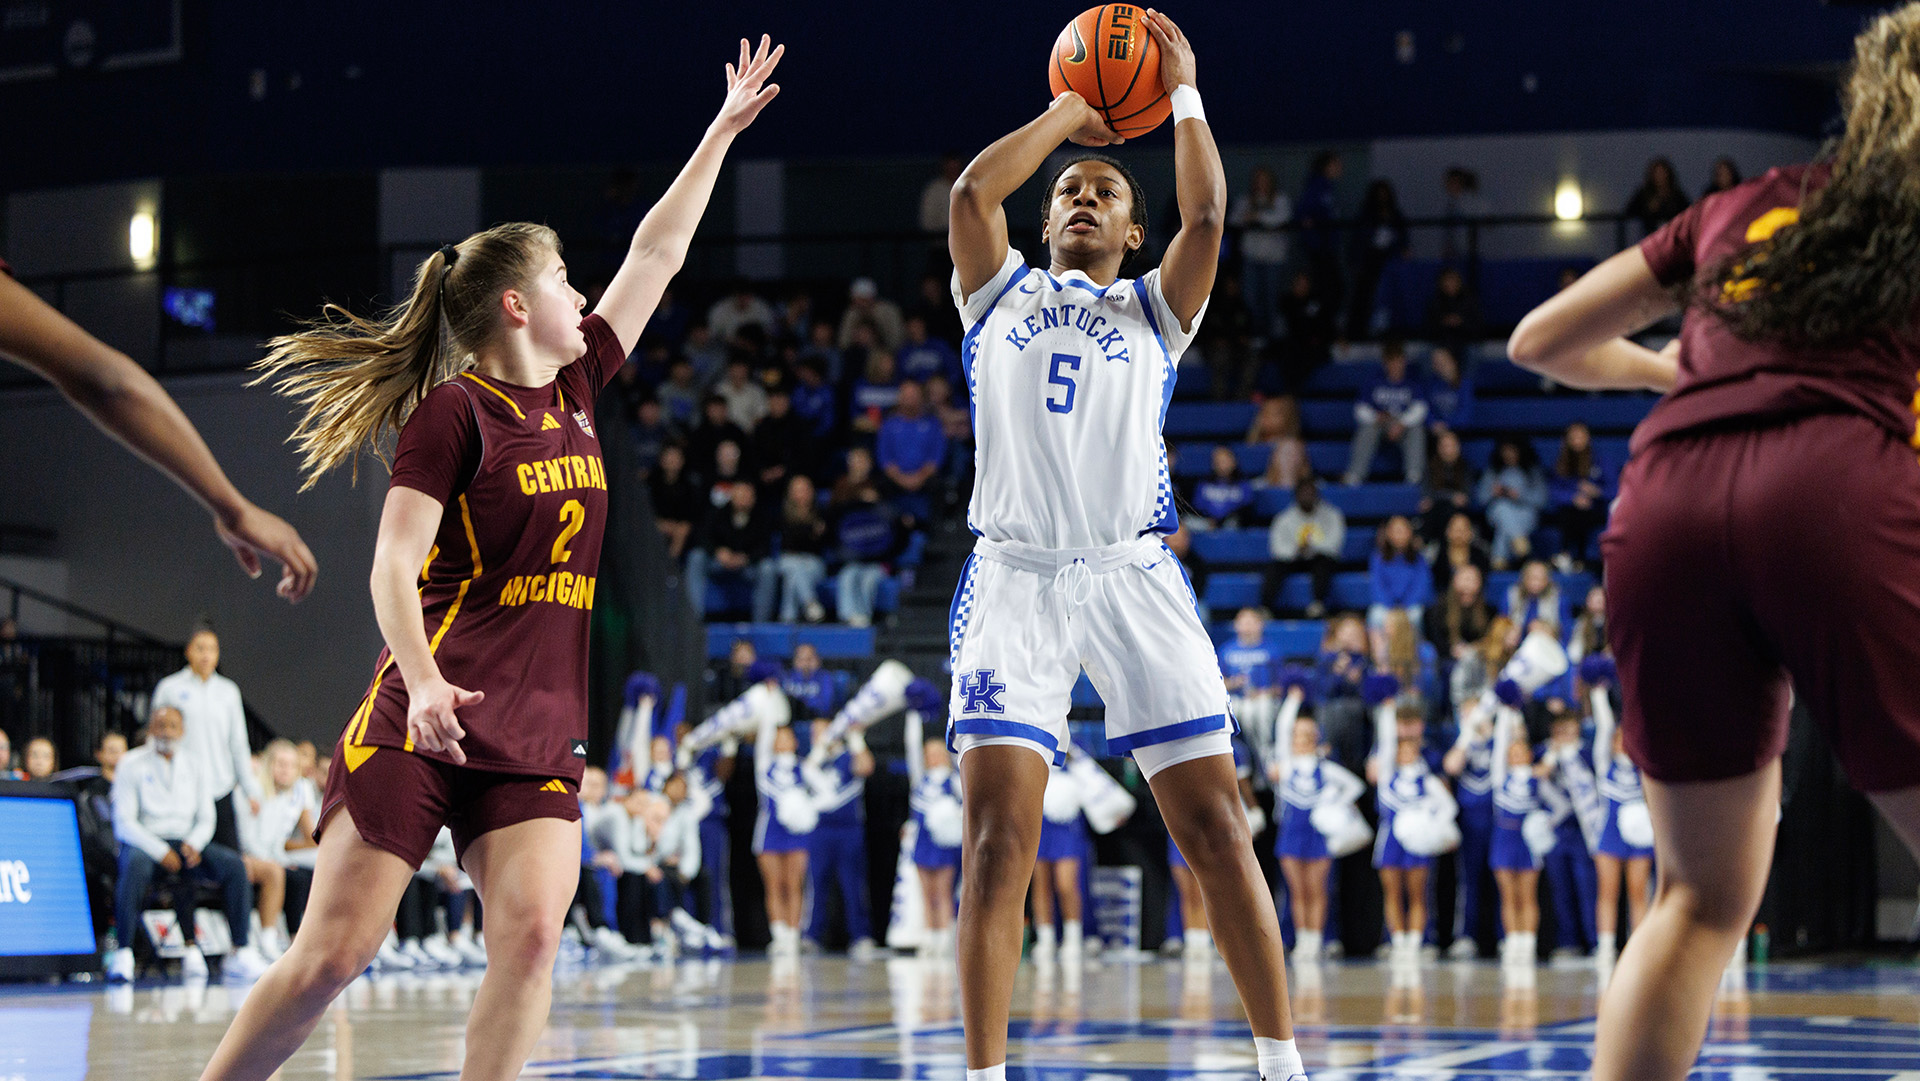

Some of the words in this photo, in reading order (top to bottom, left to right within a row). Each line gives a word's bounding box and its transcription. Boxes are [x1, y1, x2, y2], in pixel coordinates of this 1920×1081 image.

[1107, 5, 1134, 61] ELITE
[1005, 304, 1130, 364] KENTUCKY
[1046, 352, 1082, 414] 5
[516, 455, 608, 496] CENTRAL
[550, 499, 585, 564] 2
[958, 668, 1006, 714] UK
